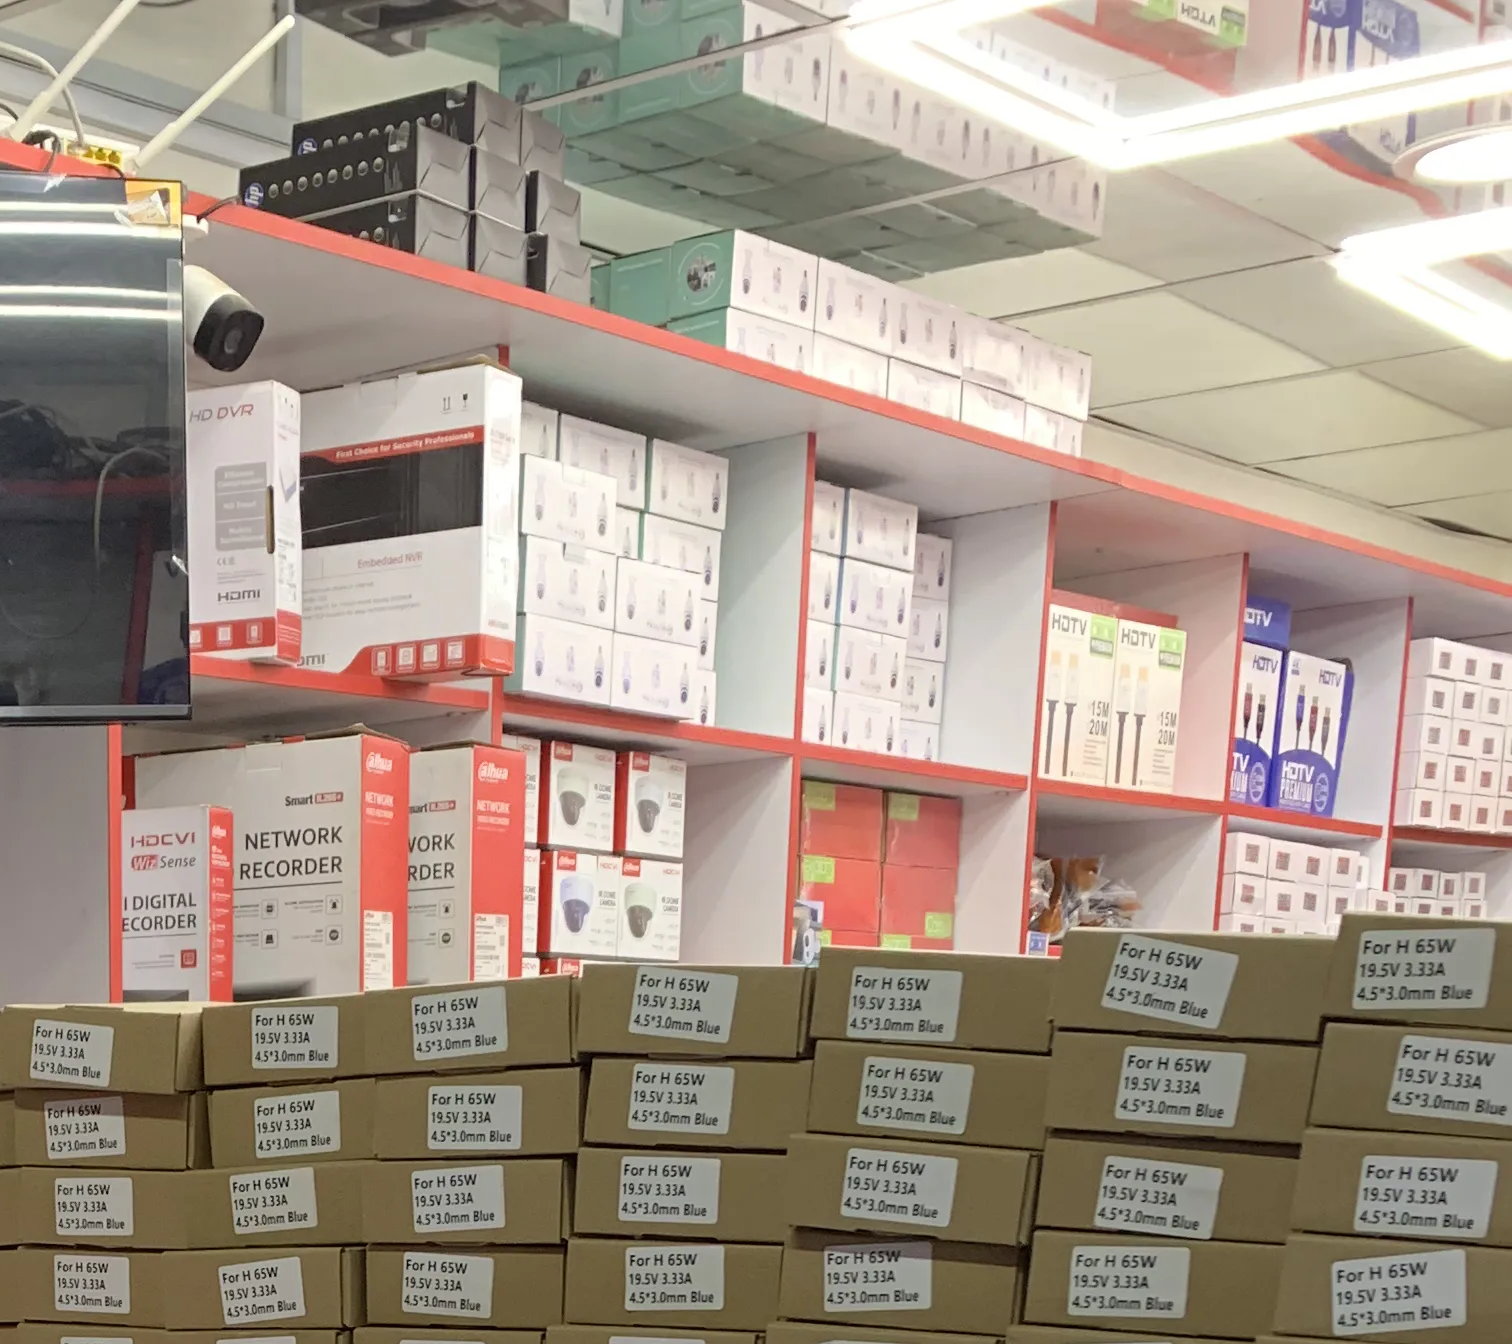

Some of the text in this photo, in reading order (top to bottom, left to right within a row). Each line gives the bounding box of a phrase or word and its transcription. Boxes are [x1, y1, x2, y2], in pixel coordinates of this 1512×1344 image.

[189, 403, 254, 423] HD DVR
[336, 430, 475, 459] First Choice for Security Professionals
[357, 552, 423, 570] Embedded NVR
[218, 588, 261, 602] HDMI
[1091, 701, 1109, 718] 15M
[1089, 718, 1108, 737] 20M
[285, 793, 314, 808] Smart
[131, 832, 196, 848] HDCVI
[245, 826, 342, 851] NETWORK
[132, 854, 196, 871] Wiz Sense
[240, 856, 342, 880] RECORDER
[133, 892, 197, 910] DIGITAL
[1363, 938, 1455, 955] For H 65W
[1360, 962, 1445, 978] 19.5V 3.33A
[1440, 985, 1473, 999] Blue
[255, 1013, 314, 1026] For H 65W
[255, 1031, 310, 1044] 19.5V 3.33A
[308, 1049, 329, 1061] Blue
